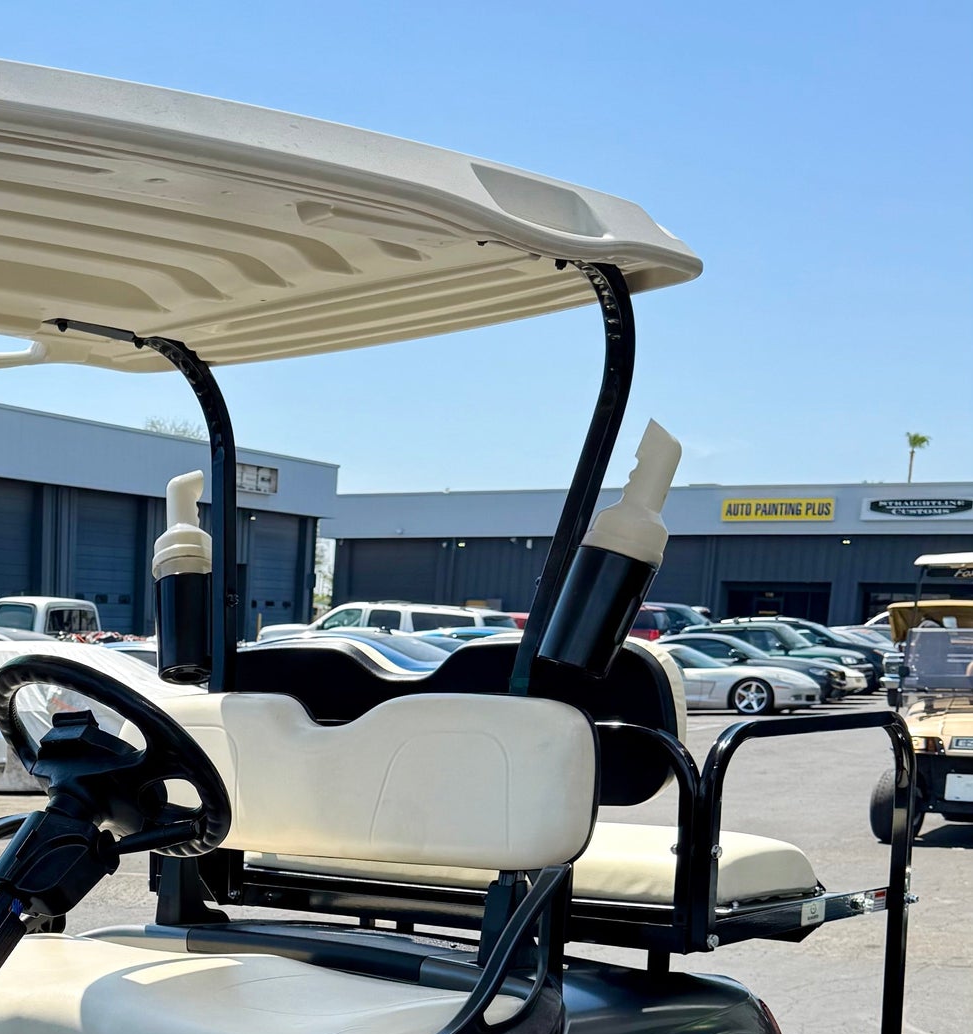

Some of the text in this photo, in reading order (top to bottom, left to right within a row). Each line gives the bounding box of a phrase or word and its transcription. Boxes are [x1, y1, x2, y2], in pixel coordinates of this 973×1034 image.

[725, 502, 832, 517] AUTO PAINTING PLUS
[891, 507, 950, 515] CUSTOMS
